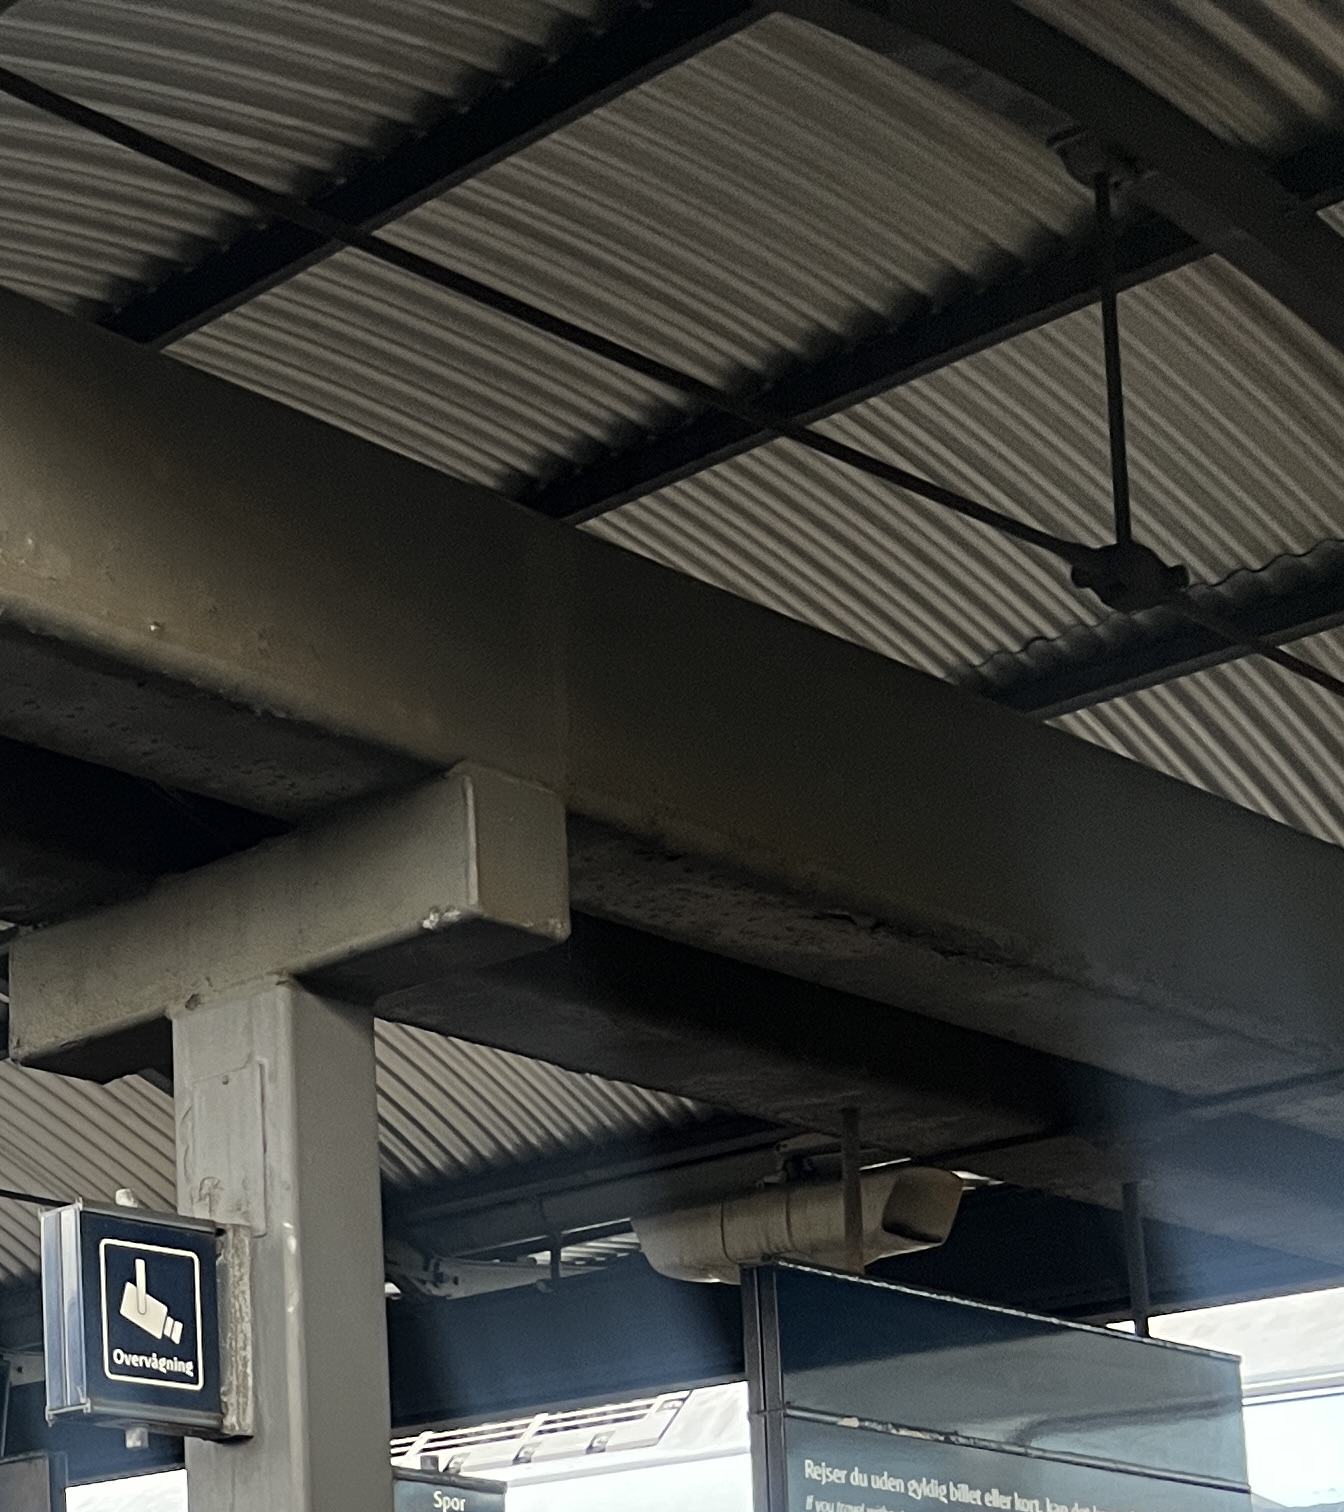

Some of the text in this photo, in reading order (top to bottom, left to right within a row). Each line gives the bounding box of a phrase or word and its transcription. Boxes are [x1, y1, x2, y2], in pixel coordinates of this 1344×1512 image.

[112, 1348, 194, 1377] Overvågning
[804, 1459, 847, 1485] Rejser
[850, 1466, 869, 1487] du
[871, 1471, 905, 1493] uden
[907, 1477, 949, 1504] gyldig
[949, 1481, 982, 1506] billet
[984, 1488, 1013, 1510] eller
[433, 1490, 466, 1512] Spor
[805, 1495, 814, 1511] If
